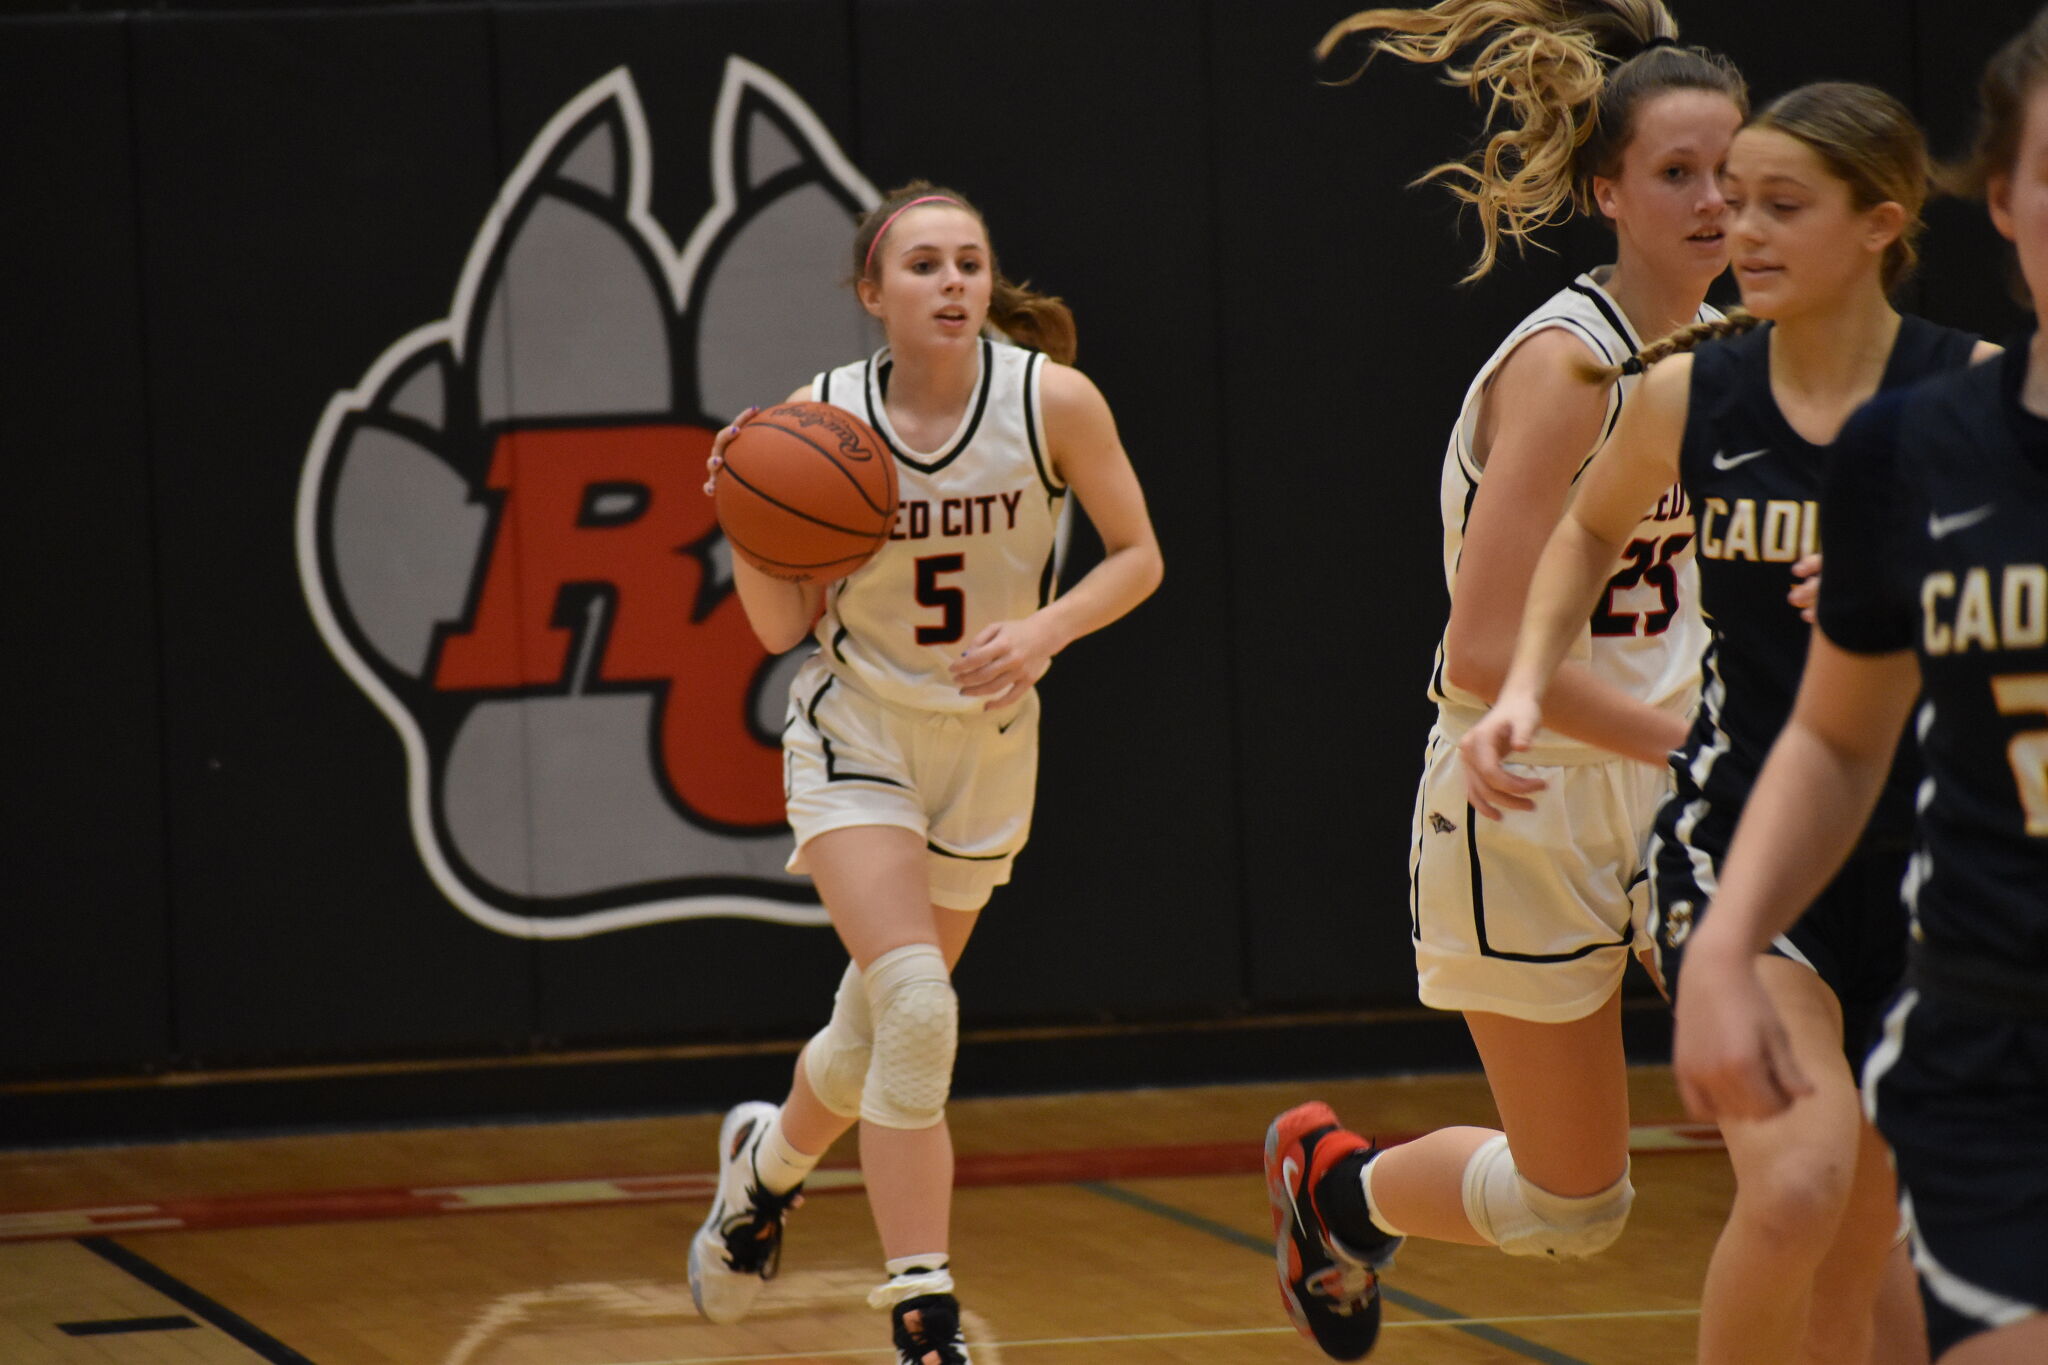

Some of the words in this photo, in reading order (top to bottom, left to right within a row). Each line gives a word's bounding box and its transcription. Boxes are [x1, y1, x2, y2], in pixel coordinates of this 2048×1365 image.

[941, 489, 1023, 537] CITY
[914, 552, 965, 646] 5
[1590, 532, 1697, 637] 25
[1921, 564, 2048, 656] CAD
